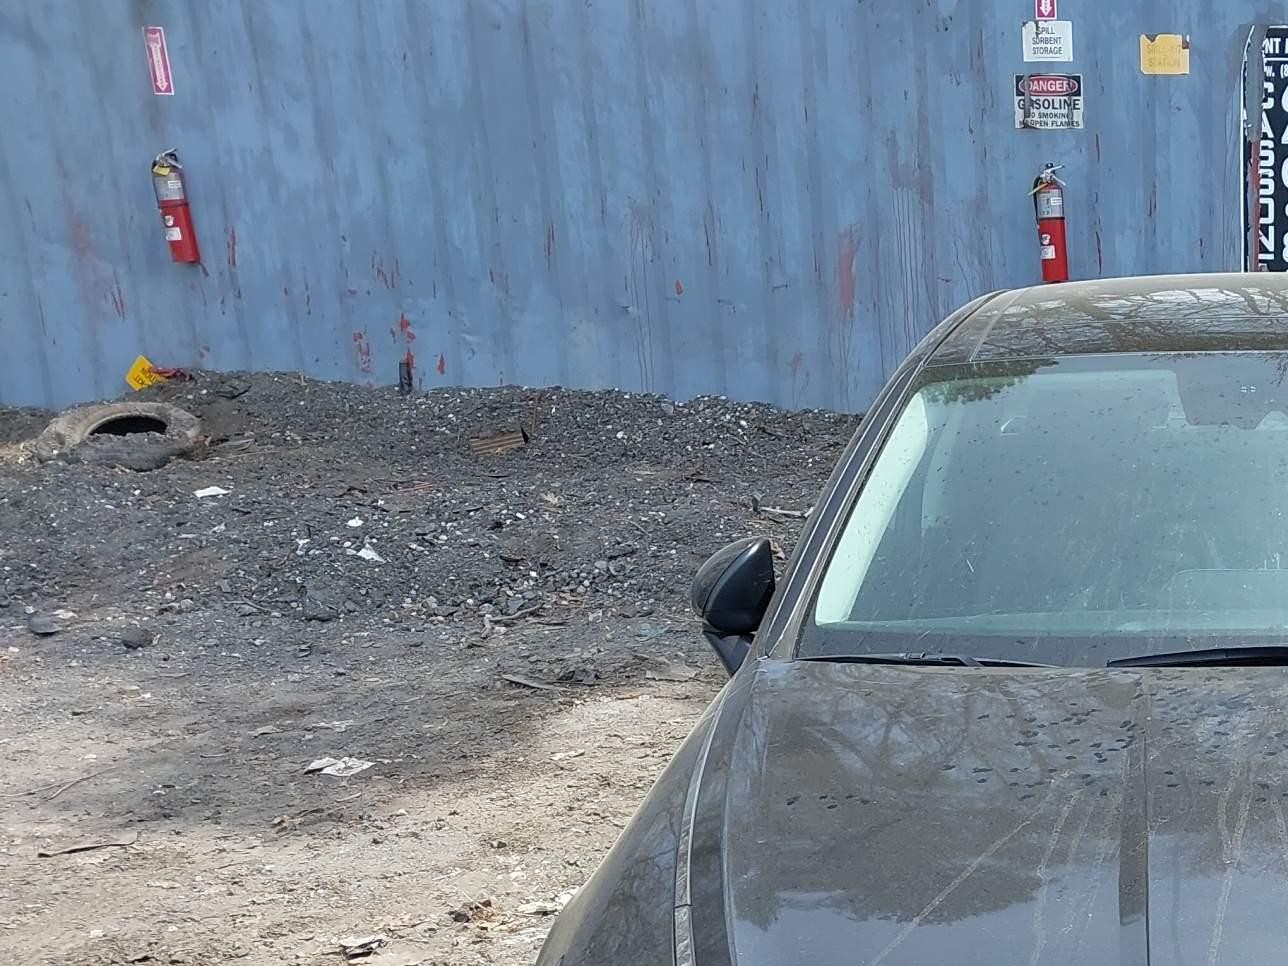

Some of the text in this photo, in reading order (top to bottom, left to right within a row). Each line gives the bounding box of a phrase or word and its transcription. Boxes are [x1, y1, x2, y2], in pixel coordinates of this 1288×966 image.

[1035, 26, 1056, 35] SPILL
[1032, 36, 1062, 45] SORBENT
[1032, 46, 1063, 55] STORAGE
